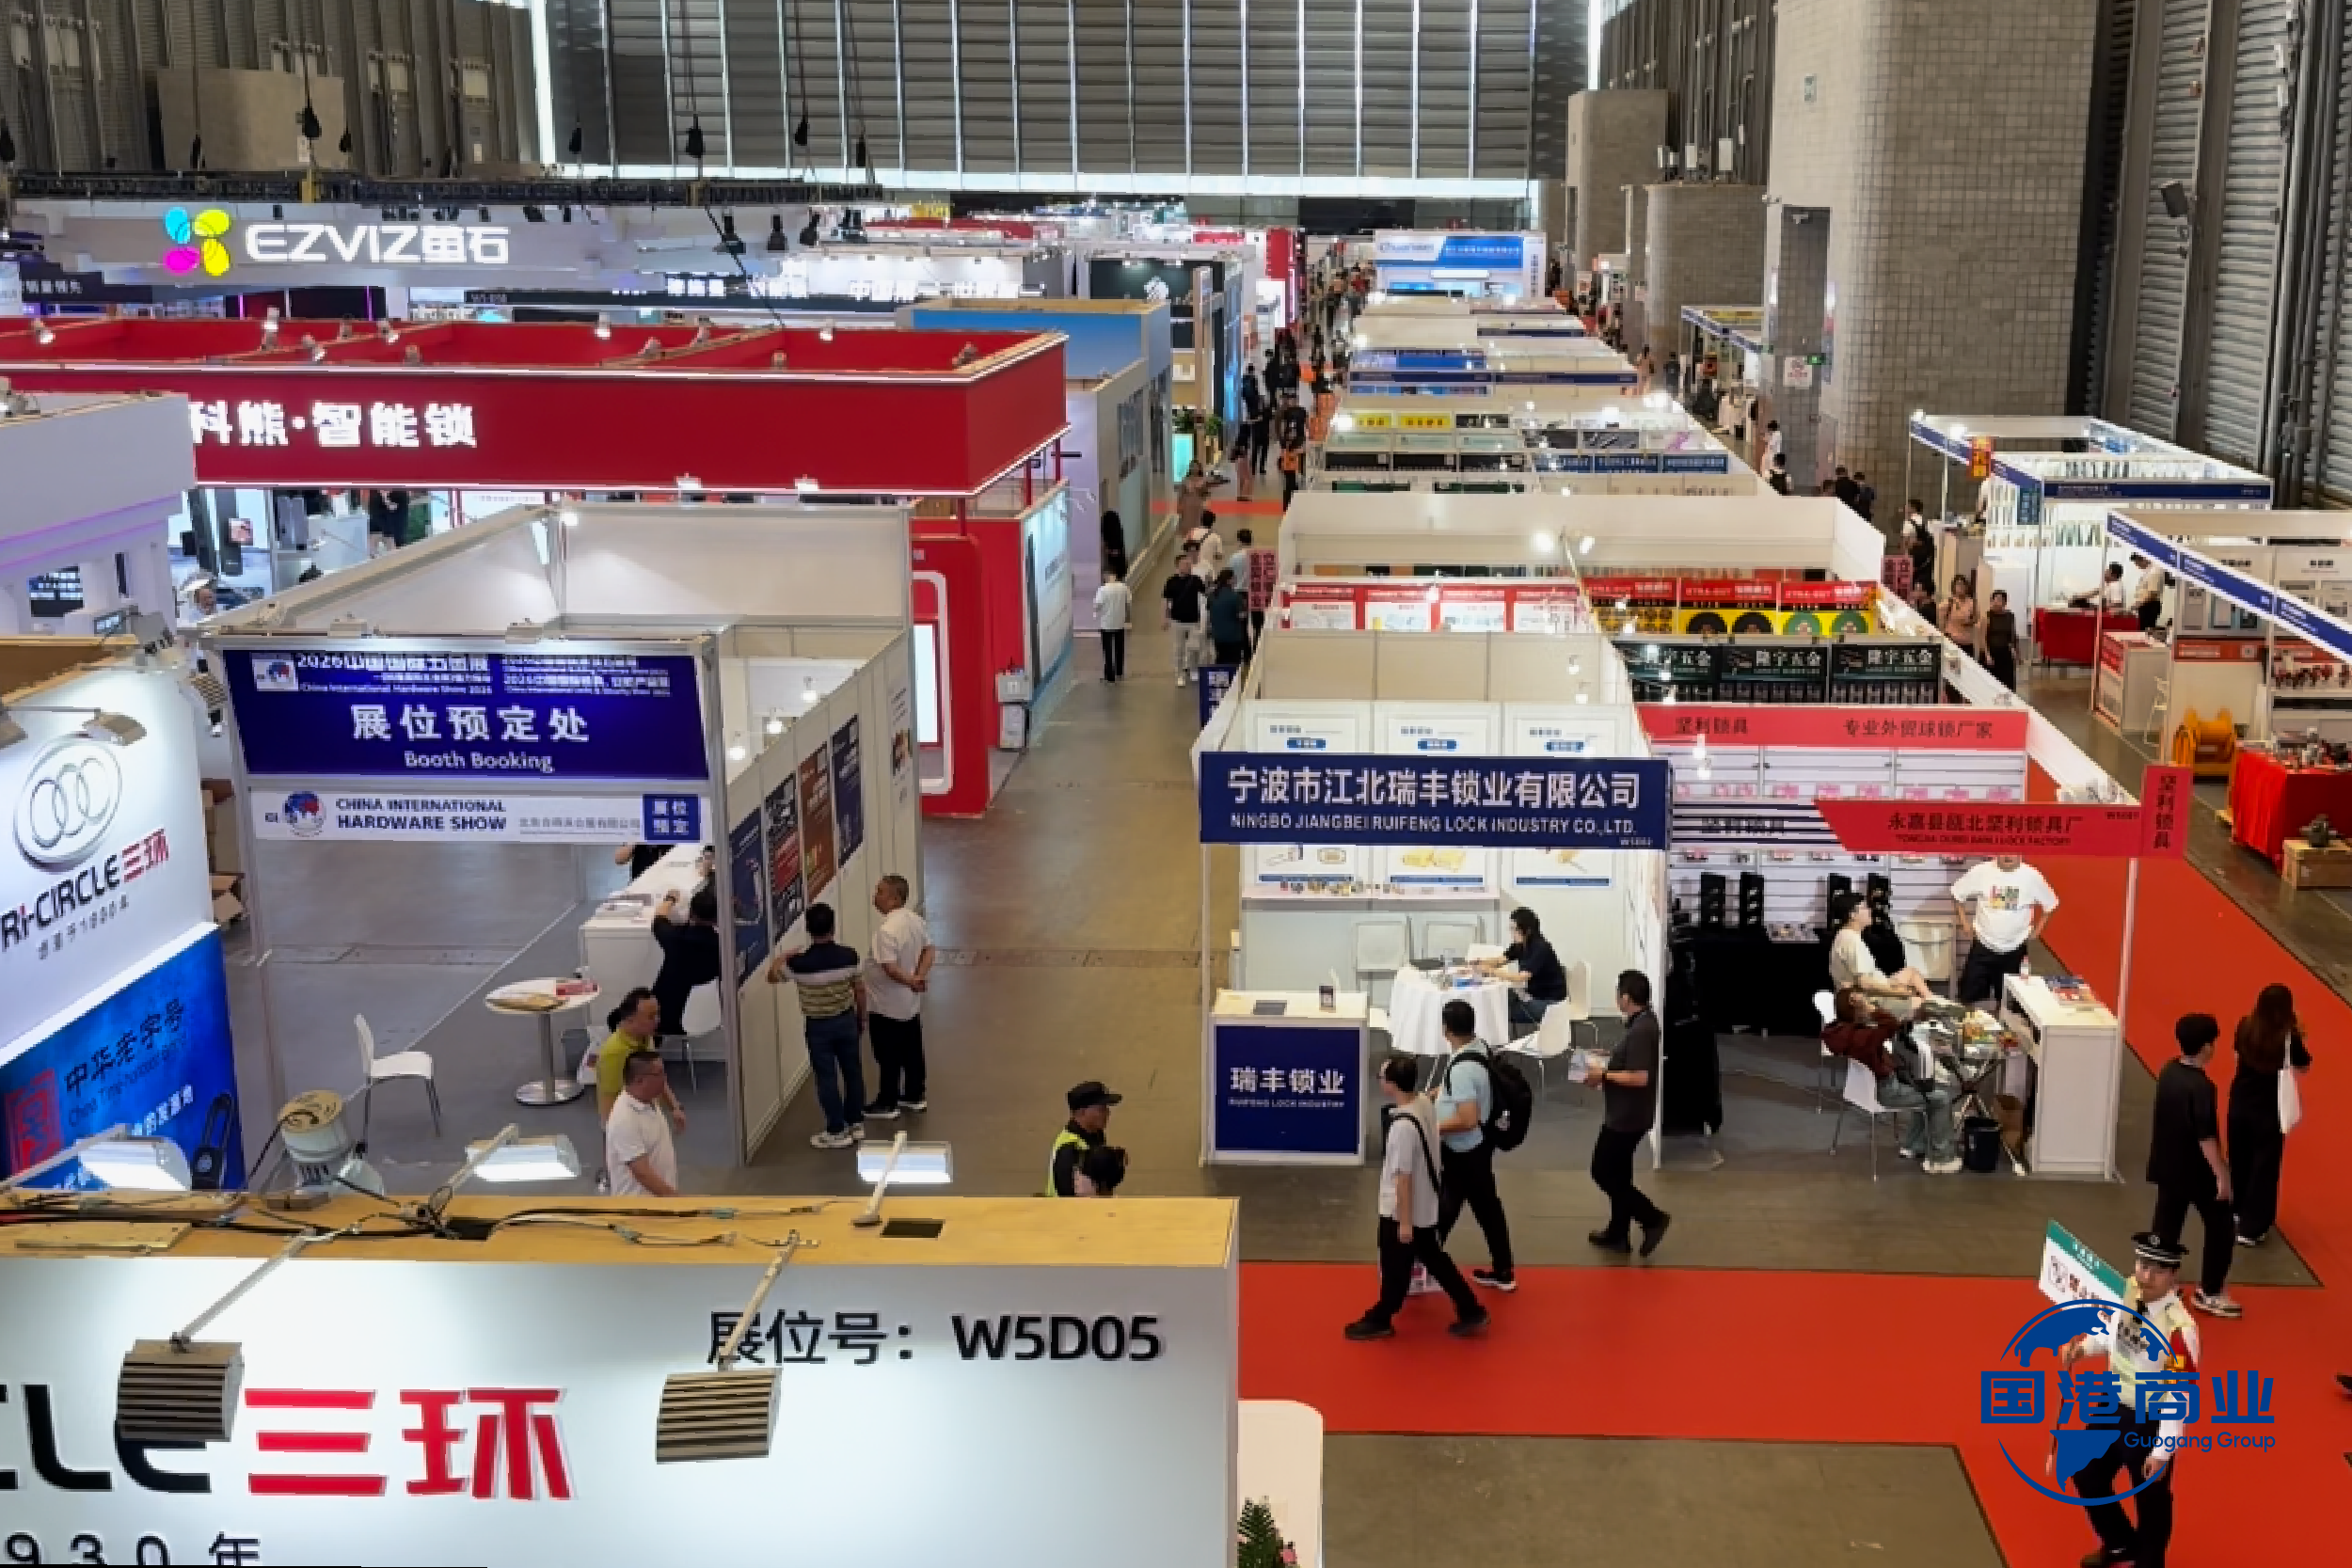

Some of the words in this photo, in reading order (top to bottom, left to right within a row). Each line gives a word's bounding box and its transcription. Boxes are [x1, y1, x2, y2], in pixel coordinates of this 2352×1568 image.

[22, 279, 83, 294] 销量领先
[351, 704, 589, 742] 展位预定处
[405, 751, 466, 768] Booth
[471, 752, 555, 773] Booking
[1228, 767, 1640, 809] 宁波市江北瑞丰锁业有限公司
[336, 798, 383, 811] CHINA
[386, 799, 506, 813] INTERNATIONAL
[338, 815, 445, 830] HARDWARE
[450, 816, 507, 832] SHOW
[1231, 812, 1292, 831] NINGBO
[1295, 813, 1370, 832] JIANGBEI
[1373, 814, 1441, 832] RUIFENG
[1444, 815, 1487, 832] LOCK
[1491, 816, 1568, 834] INDUSTRY
[64, 998, 184, 1098] 中华老字号
[1230, 1067, 1345, 1095] 瑞丰锁业
[951, 1314, 1162, 1362] W5D05
[245, 1388, 572, 1500] 三环
